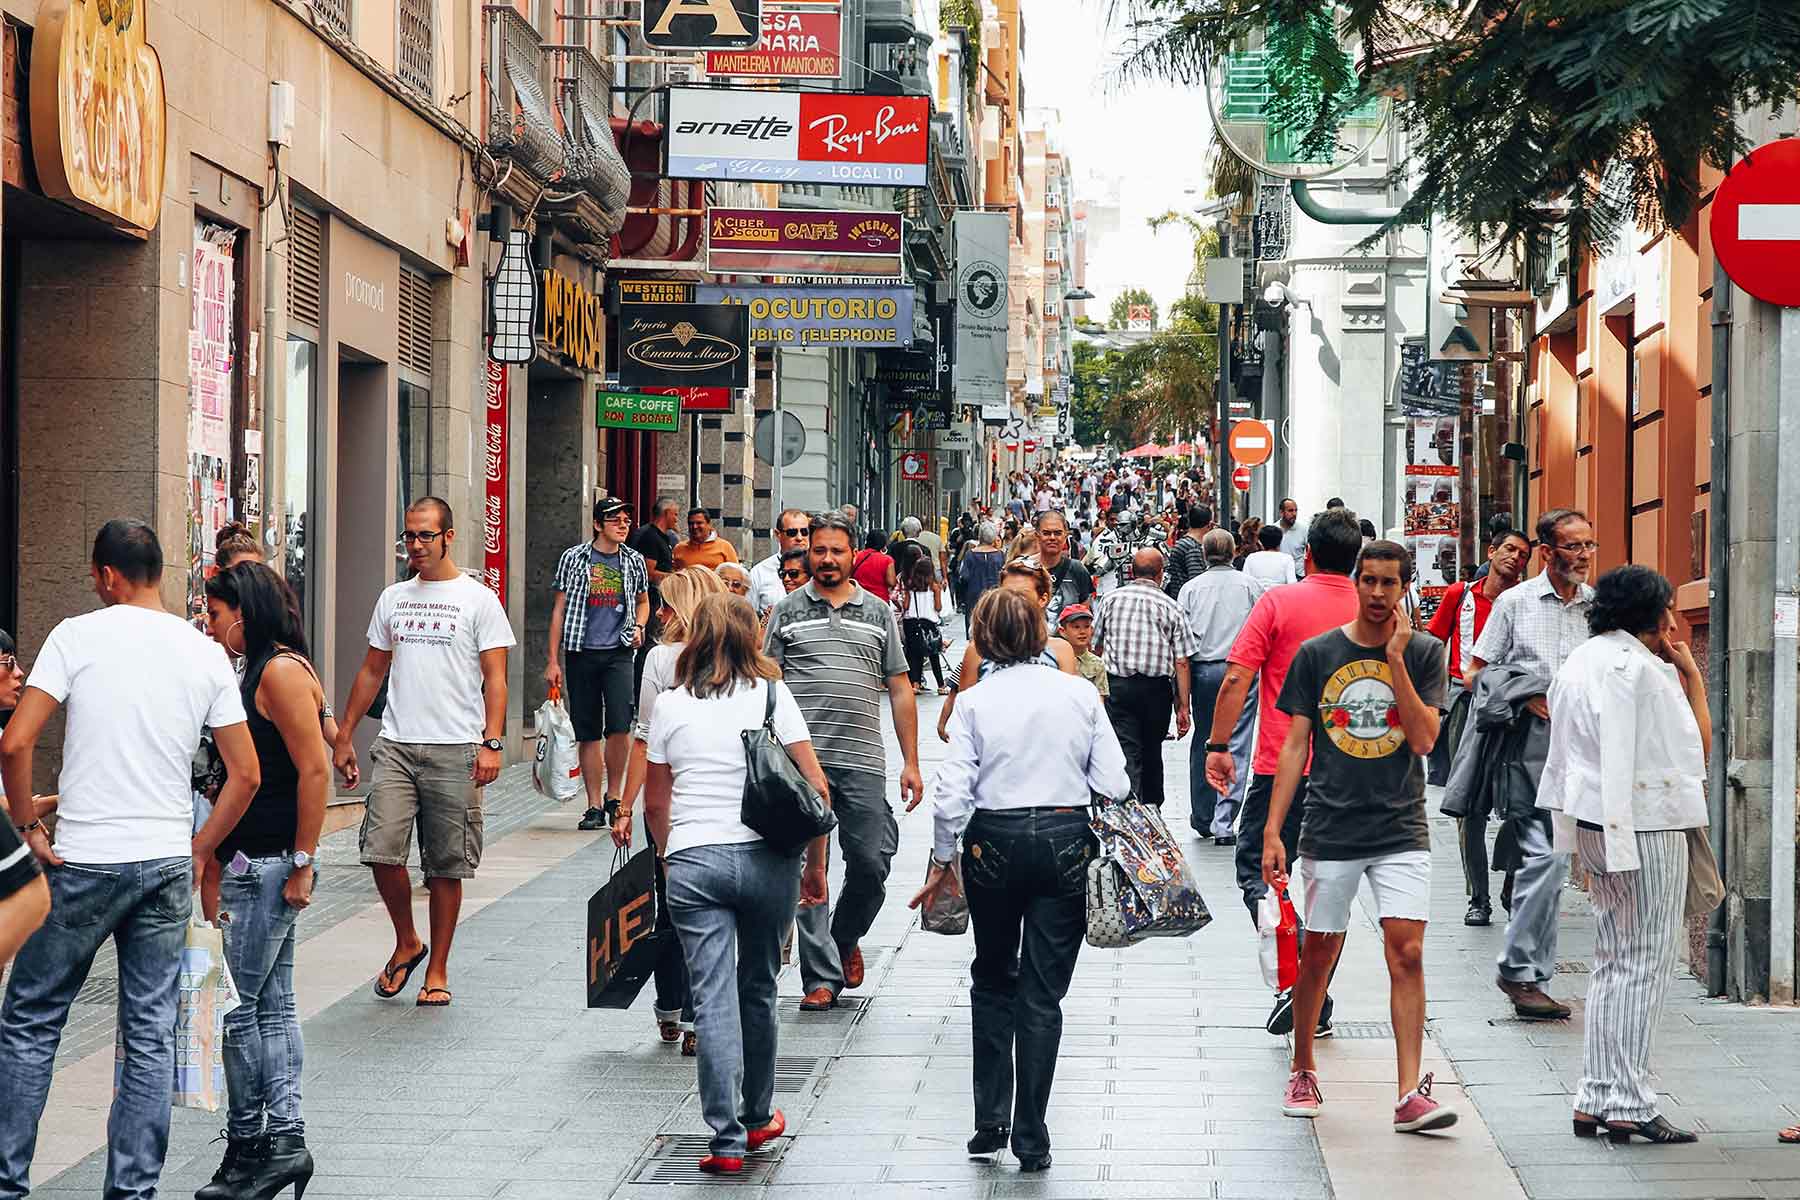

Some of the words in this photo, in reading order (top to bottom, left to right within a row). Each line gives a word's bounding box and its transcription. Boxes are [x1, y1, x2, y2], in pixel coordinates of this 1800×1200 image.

[762, 15, 802, 31] ESA
[773, 57, 780, 73] Y
[781, 57, 834, 75] MANTONES
[676, 116, 793, 140] arnette
[832, 166, 880, 179] LOCAL
[887, 167, 903, 180] 10
[725, 217, 764, 228] CIBER
[734, 228, 778, 238] SCOUT
[785, 220, 839, 240] CAFÉ
[623, 284, 683, 293] WESTERN
[642, 293, 683, 302] UNION
[737, 295, 896, 320] OCUTORIO
[563, 277, 601, 369] ROSA
[750, 328, 793, 341] UBLIC
[802, 328, 896, 342] TELEPHONE
[641, 344, 693, 358] Encarna
[640, 400, 674, 412] COFFE
